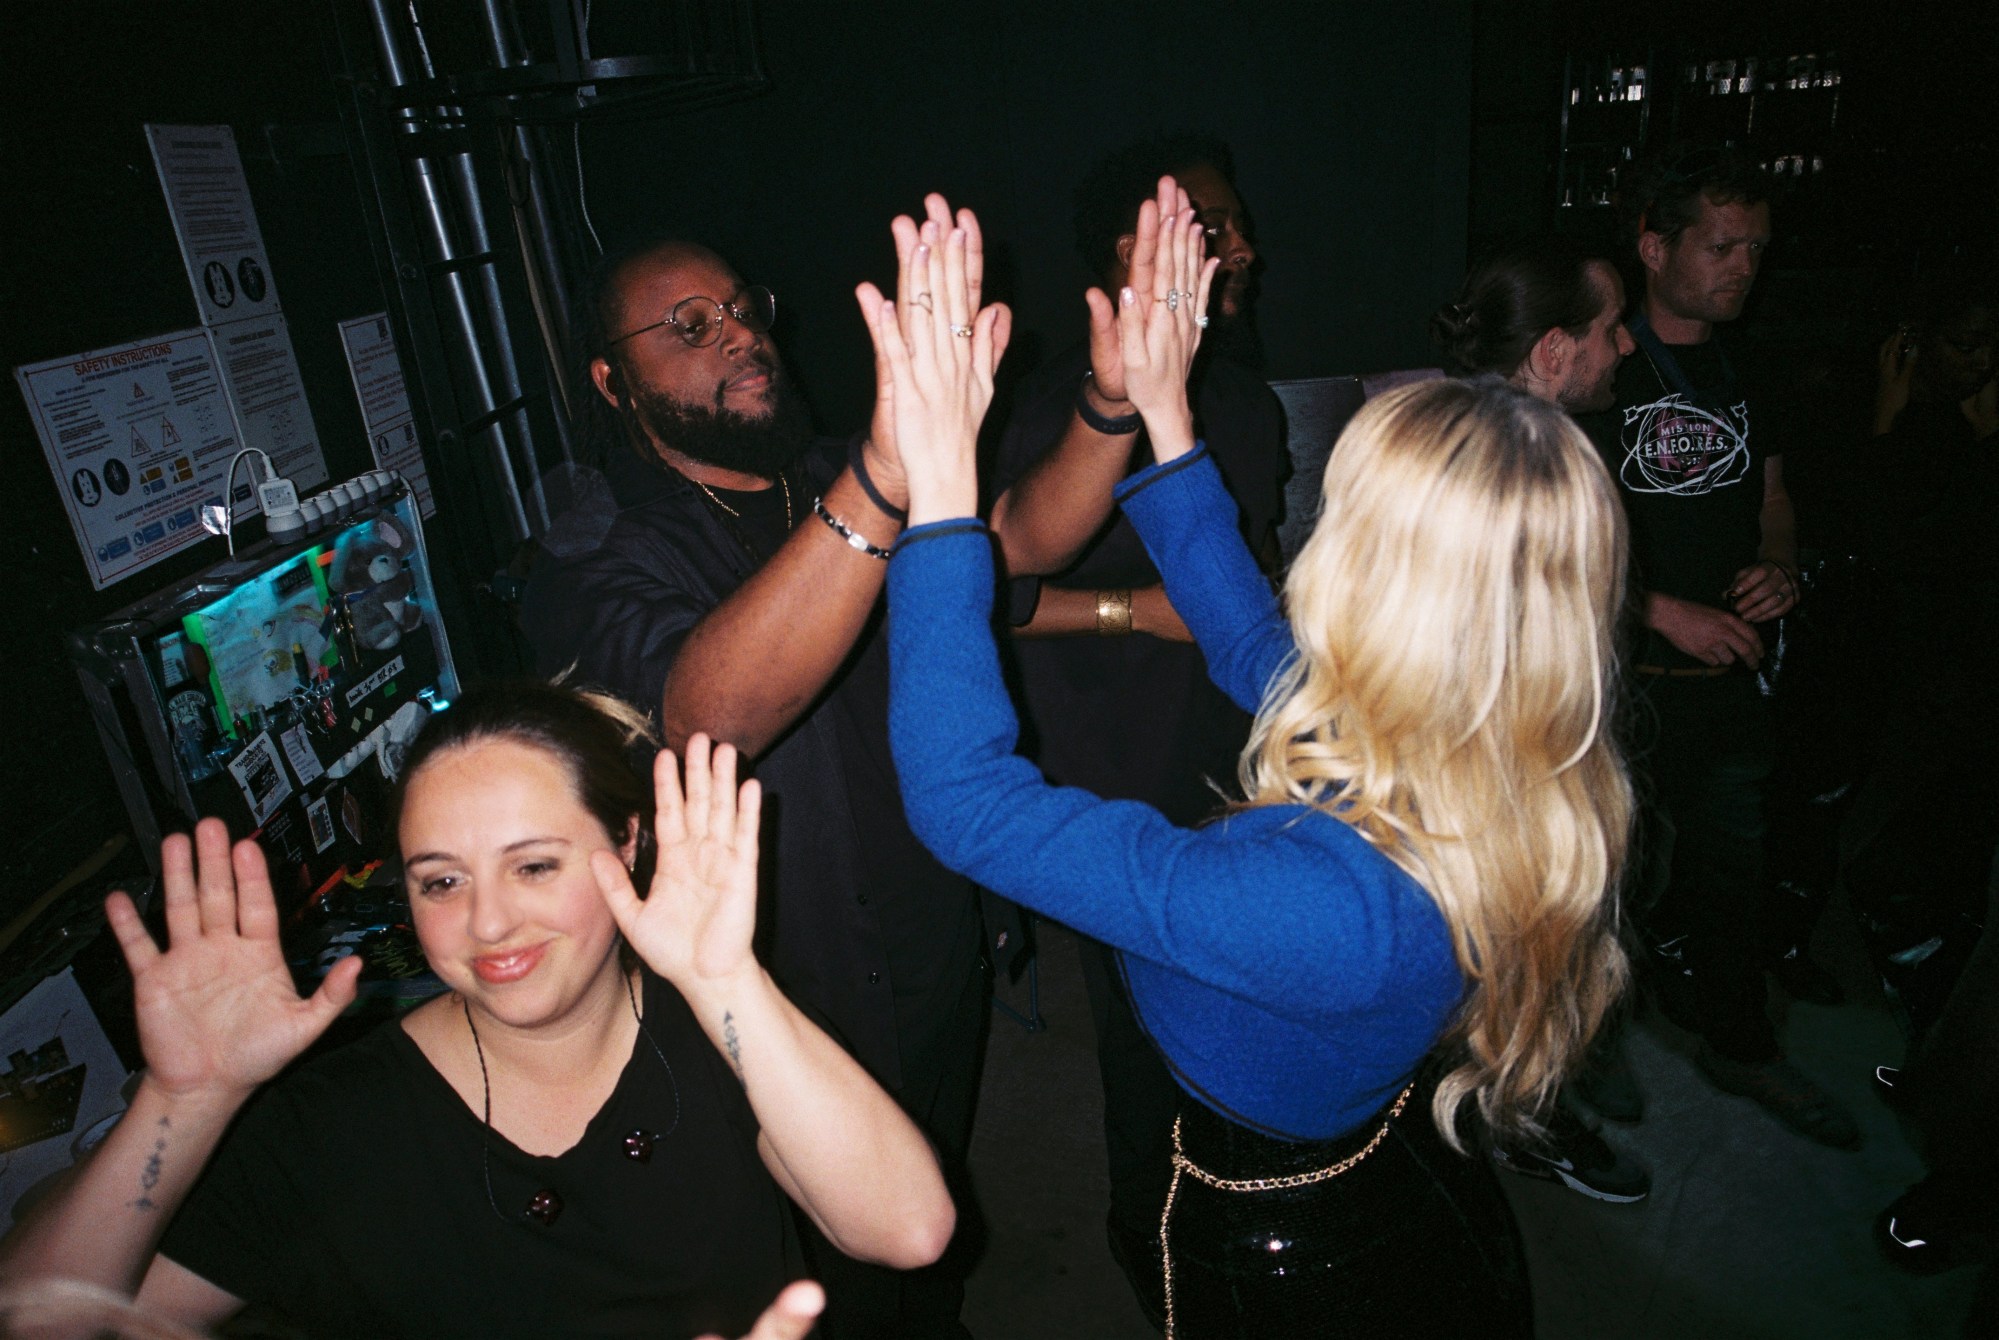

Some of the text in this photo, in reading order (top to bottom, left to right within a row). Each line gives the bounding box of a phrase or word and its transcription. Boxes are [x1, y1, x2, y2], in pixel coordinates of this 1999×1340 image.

[74, 345, 172, 376] SAFETY INSTRUCTIONS
[1661, 423, 1710, 437] MISION
